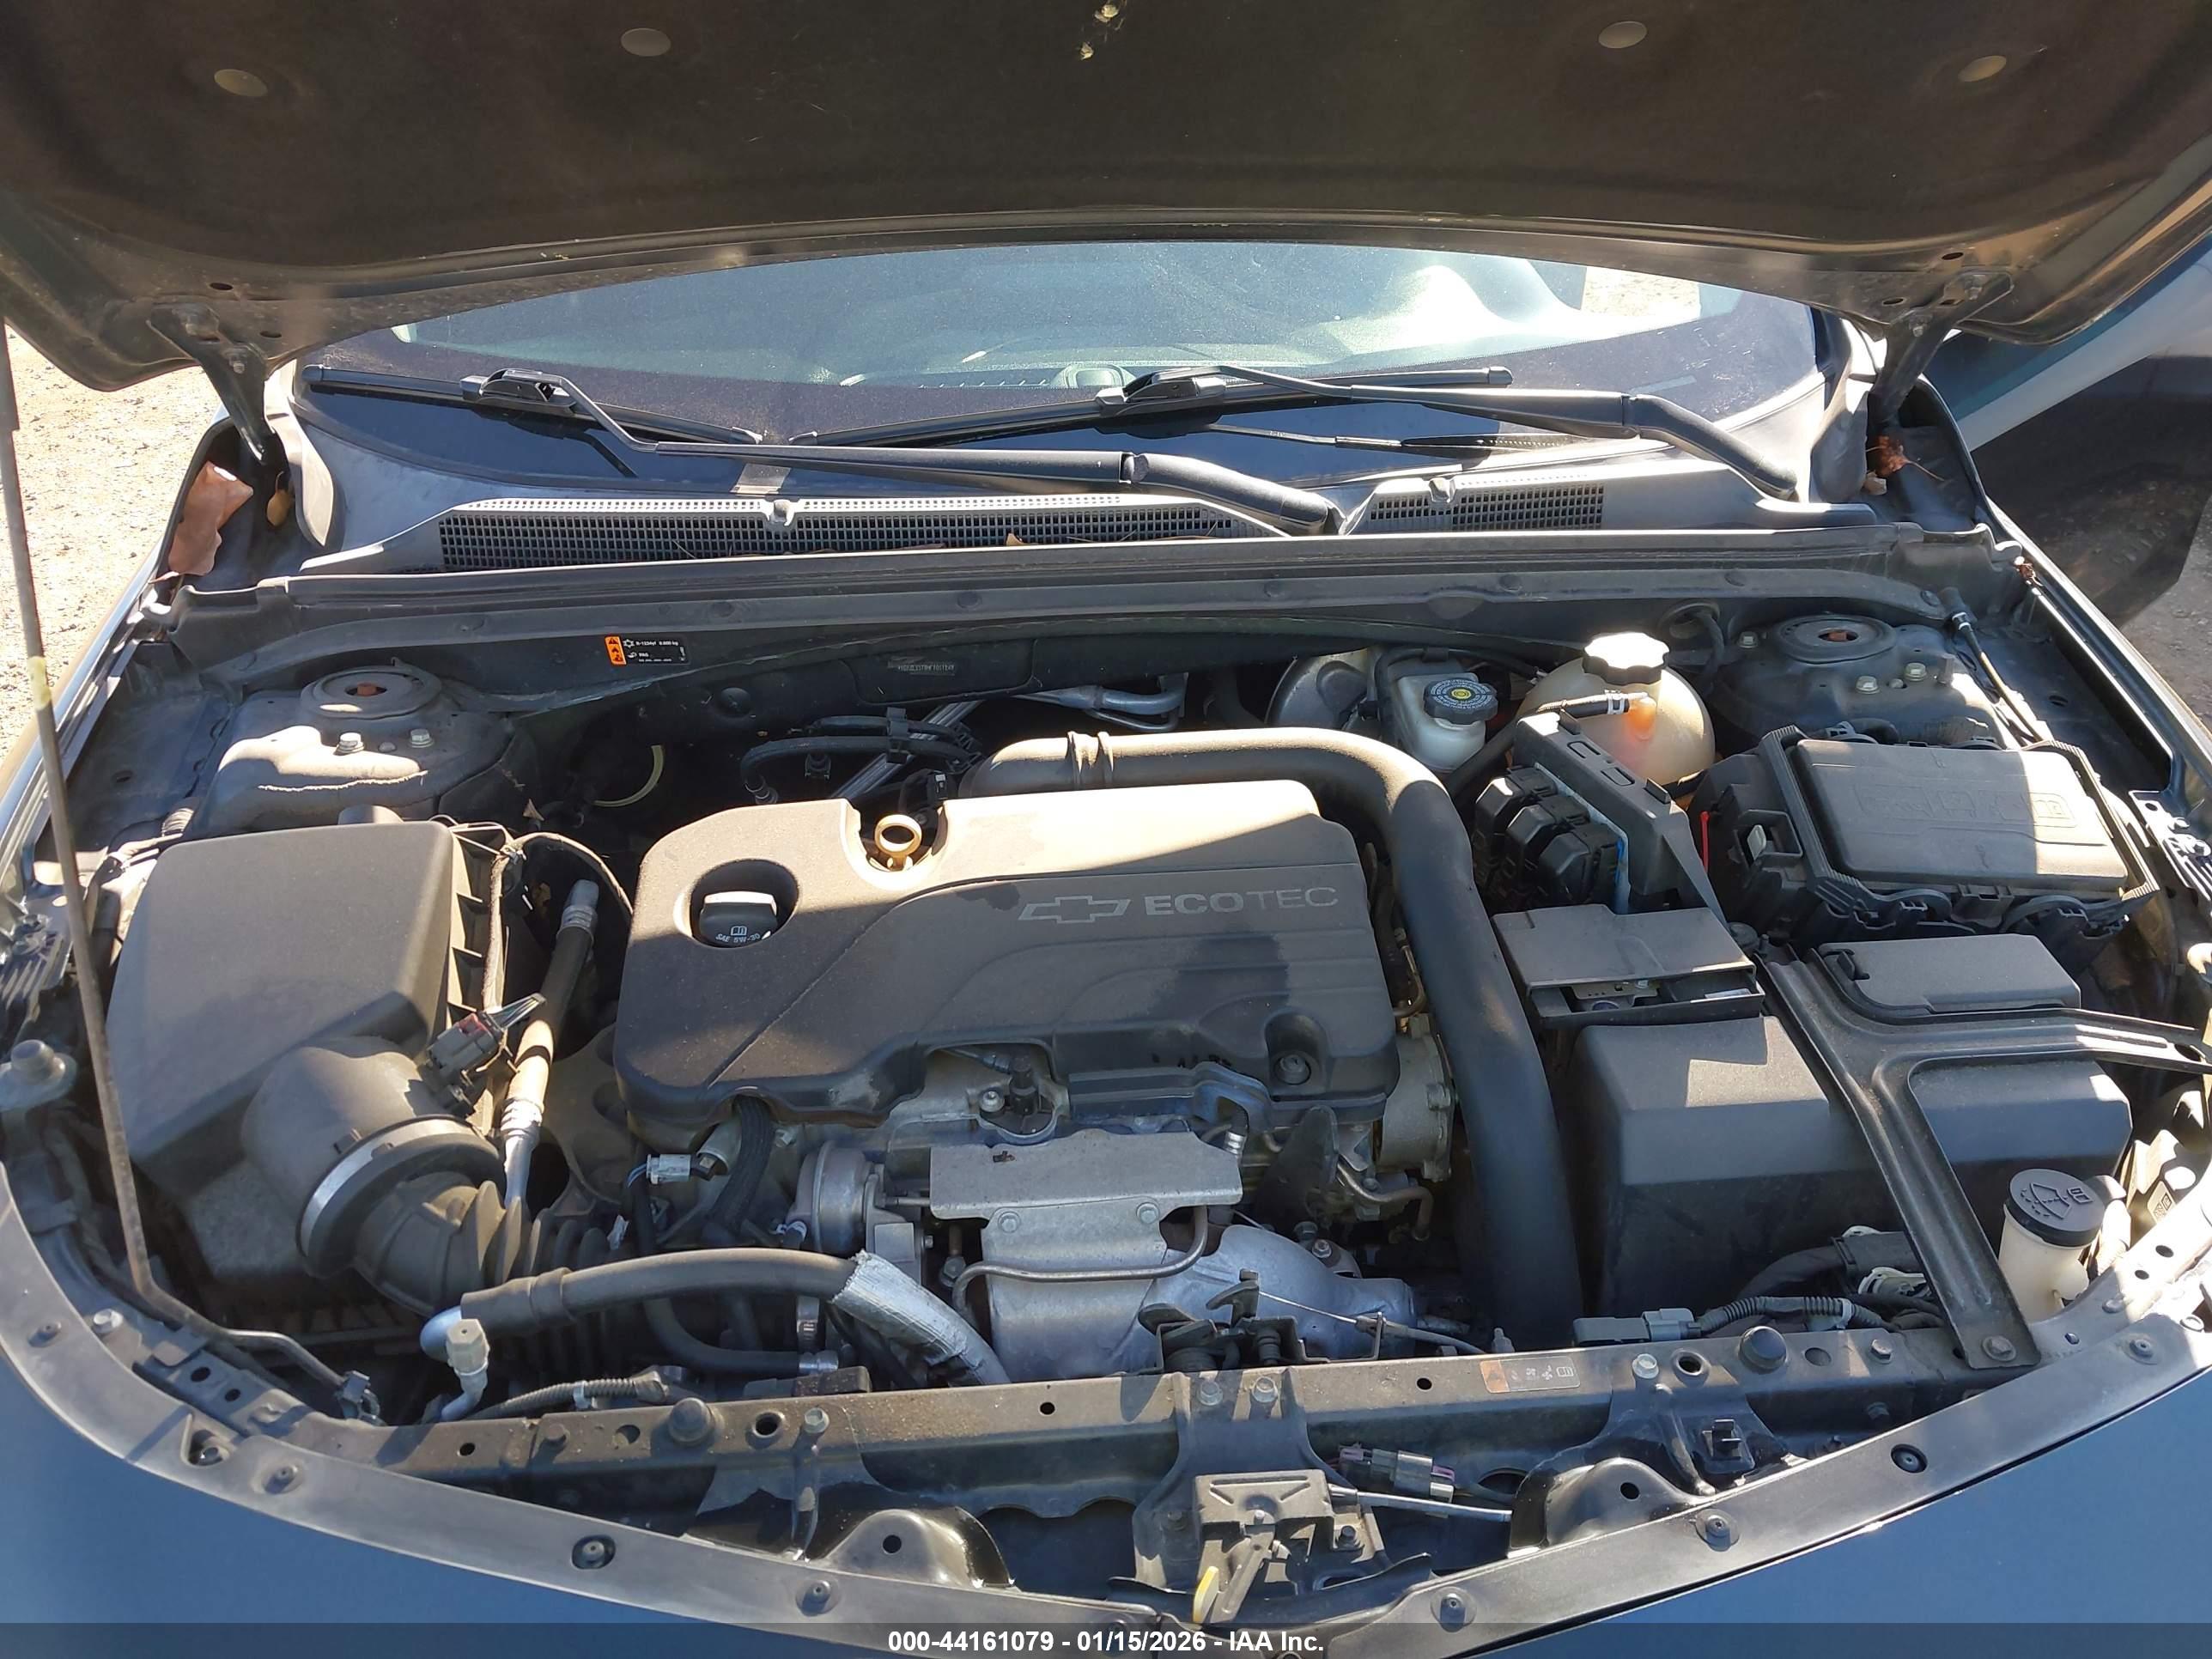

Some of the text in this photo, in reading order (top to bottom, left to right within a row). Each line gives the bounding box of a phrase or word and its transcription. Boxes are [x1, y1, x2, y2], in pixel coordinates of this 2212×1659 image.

[1144, 886, 1339, 915] ECOTEC
[715, 933, 761, 943] SAE 5W-30
